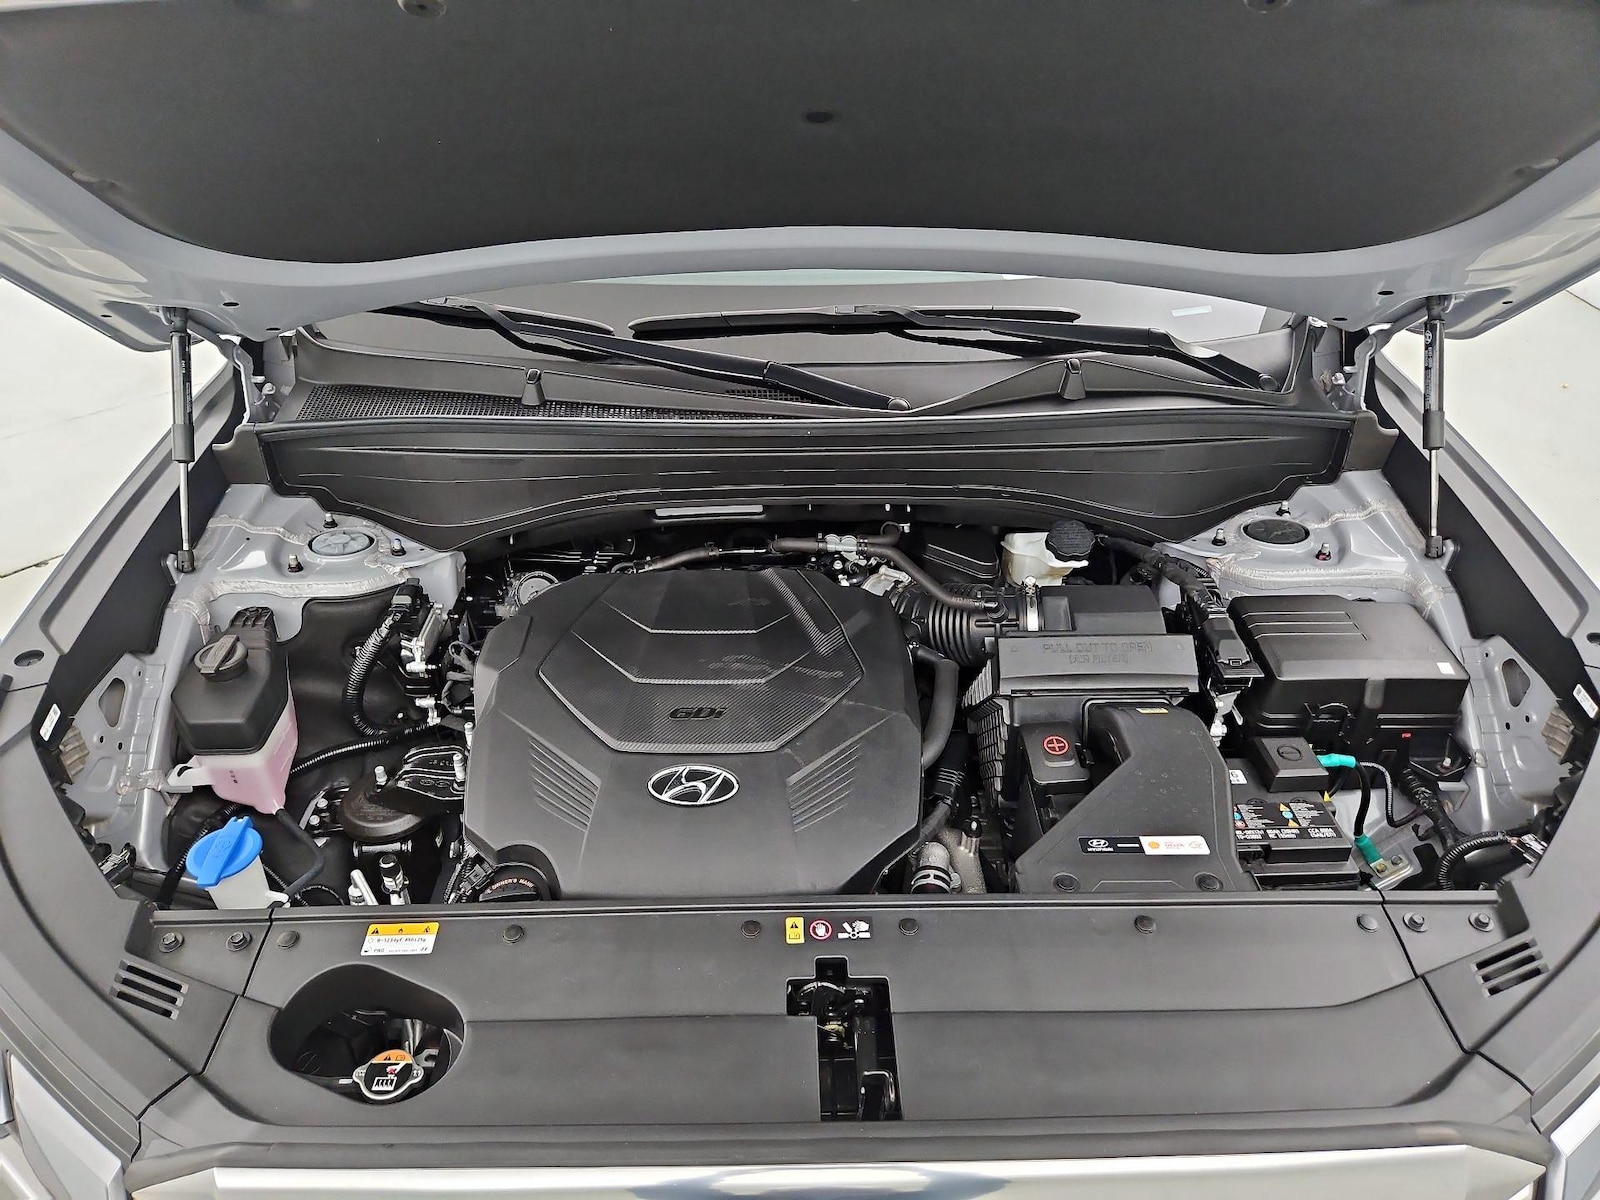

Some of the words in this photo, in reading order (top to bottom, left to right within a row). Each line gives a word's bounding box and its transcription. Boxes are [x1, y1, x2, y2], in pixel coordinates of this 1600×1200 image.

[1042, 642, 1073, 653] PULL
[1075, 642, 1099, 653] OUT
[1102, 642, 1118, 653] TO
[1121, 641, 1153, 653] OPEN
